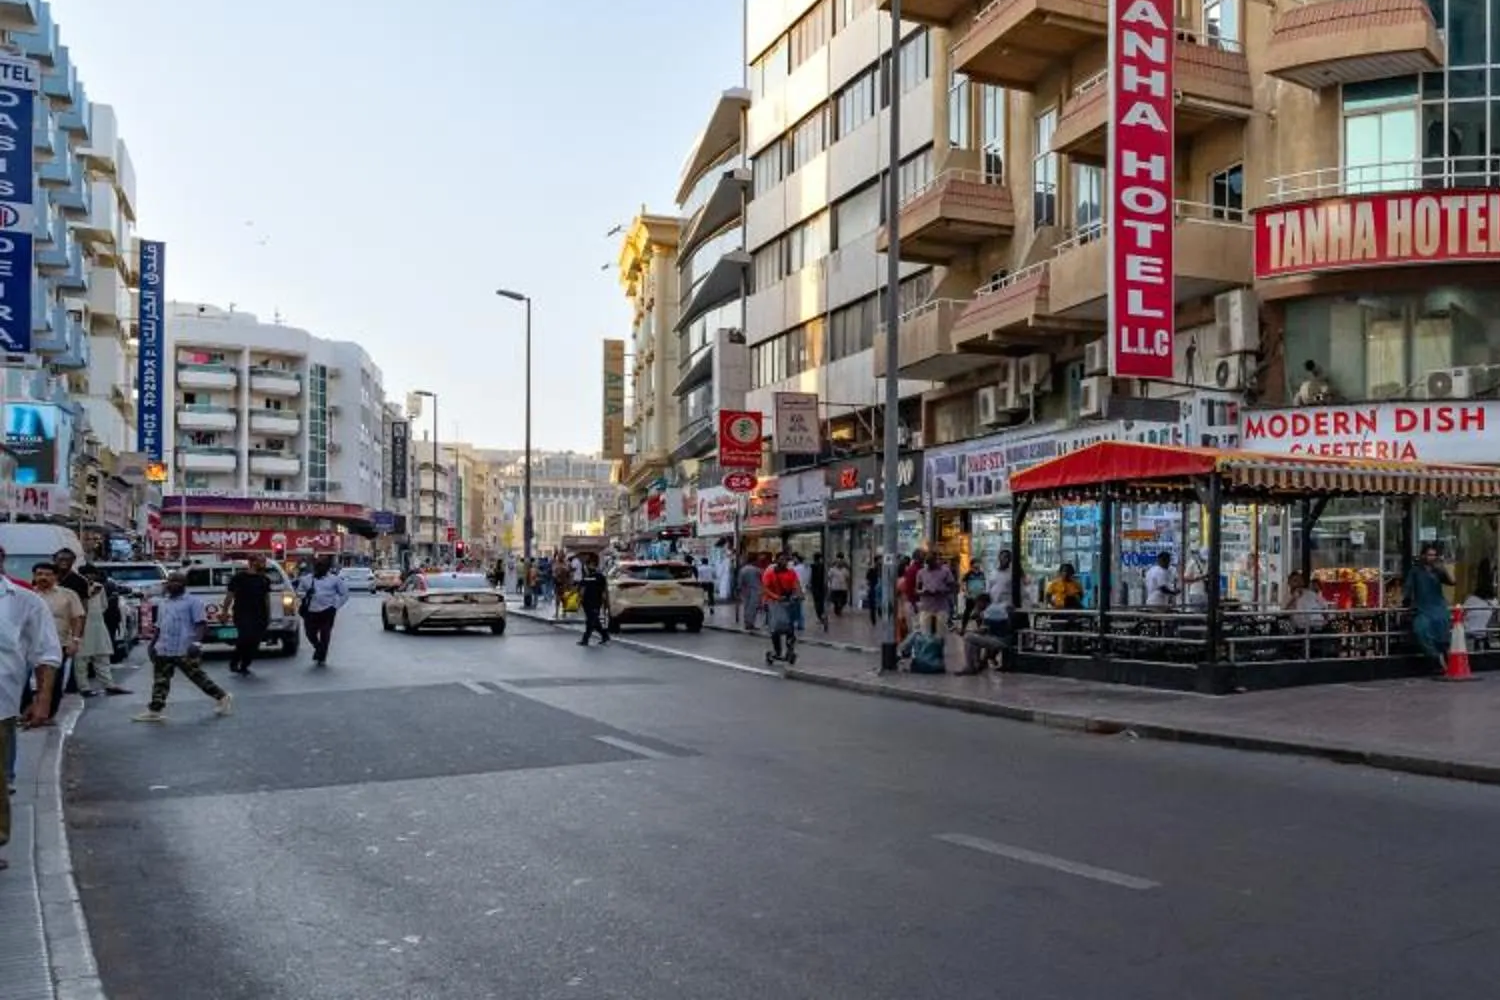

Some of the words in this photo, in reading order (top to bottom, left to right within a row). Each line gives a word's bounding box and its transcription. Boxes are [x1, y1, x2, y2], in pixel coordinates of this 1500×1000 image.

[1120, 148, 1167, 318] HOTEL
[1265, 202, 1377, 270] TANHA
[1245, 409, 1378, 439] MODERN
[1395, 407, 1485, 432] DISH
[1290, 440, 1417, 461] CAFETERIA
[191, 530, 261, 547] WIMPY
